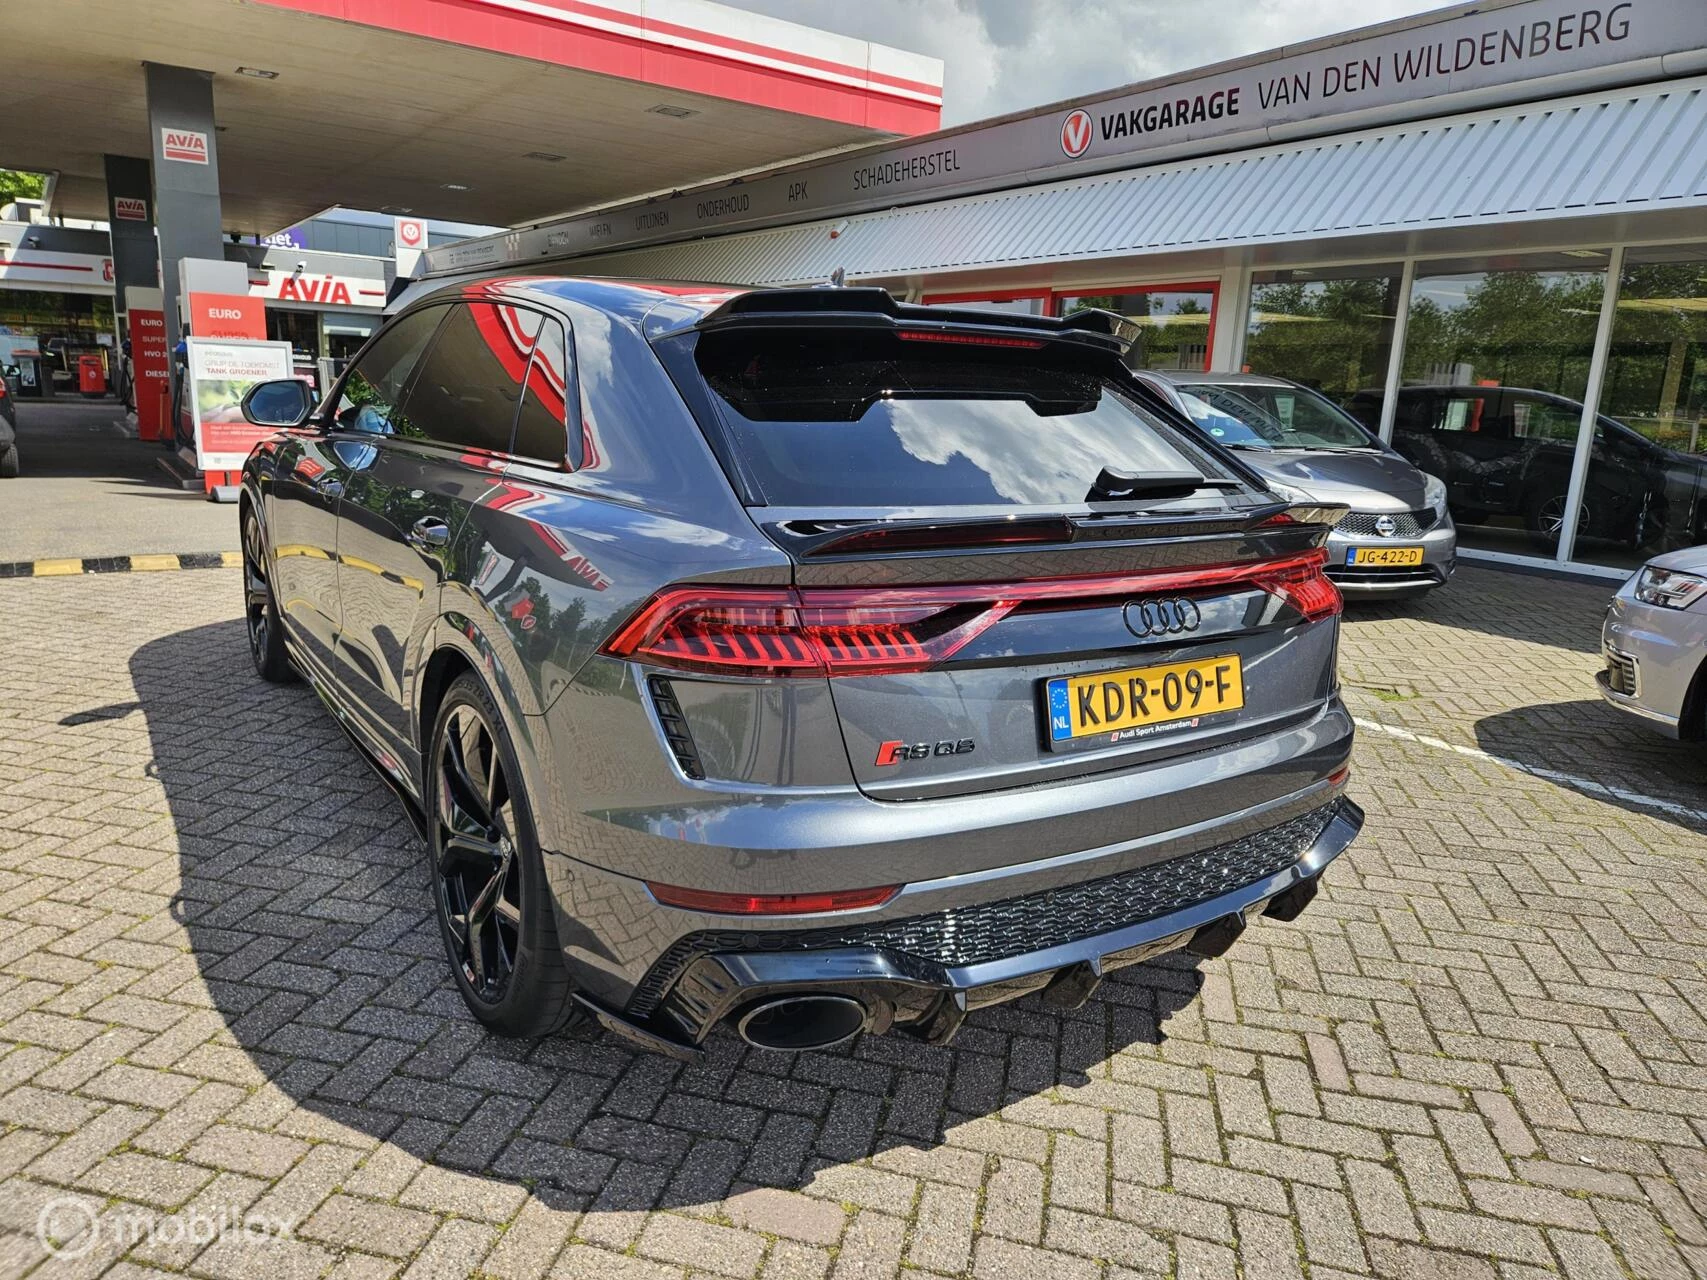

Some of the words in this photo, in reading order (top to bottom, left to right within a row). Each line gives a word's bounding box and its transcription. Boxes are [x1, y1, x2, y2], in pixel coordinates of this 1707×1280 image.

[1100, 87, 1241, 141] VAKGARAGE
[1257, 71, 1311, 110] VAN
[1322, 56, 1382, 98] DEN
[1393, 2, 1633, 84] WILDENBERG
[166, 133, 205, 150] AVIA
[852, 148, 961, 191] SCHADEHERSTEL
[787, 181, 809, 202] APK
[696, 194, 750, 220] ONDERHOUD
[634, 211, 671, 231] UITLIJNEN
[278, 273, 353, 305] AVIA
[140, 318, 164, 328] EURO
[208, 307, 242, 320] EURO
[144, 350, 161, 358] HVO
[206, 367, 228, 375] TANK
[1358, 550, 1418, 563] JG-422-D
[1077, 665, 1231, 728] KDR-09-F
[1053, 715, 1069, 730] NL
[1119, 730, 1135, 739] Audi
[1135, 727, 1154, 737] Sport
[1154, 719, 1192, 733] Amsterdam
